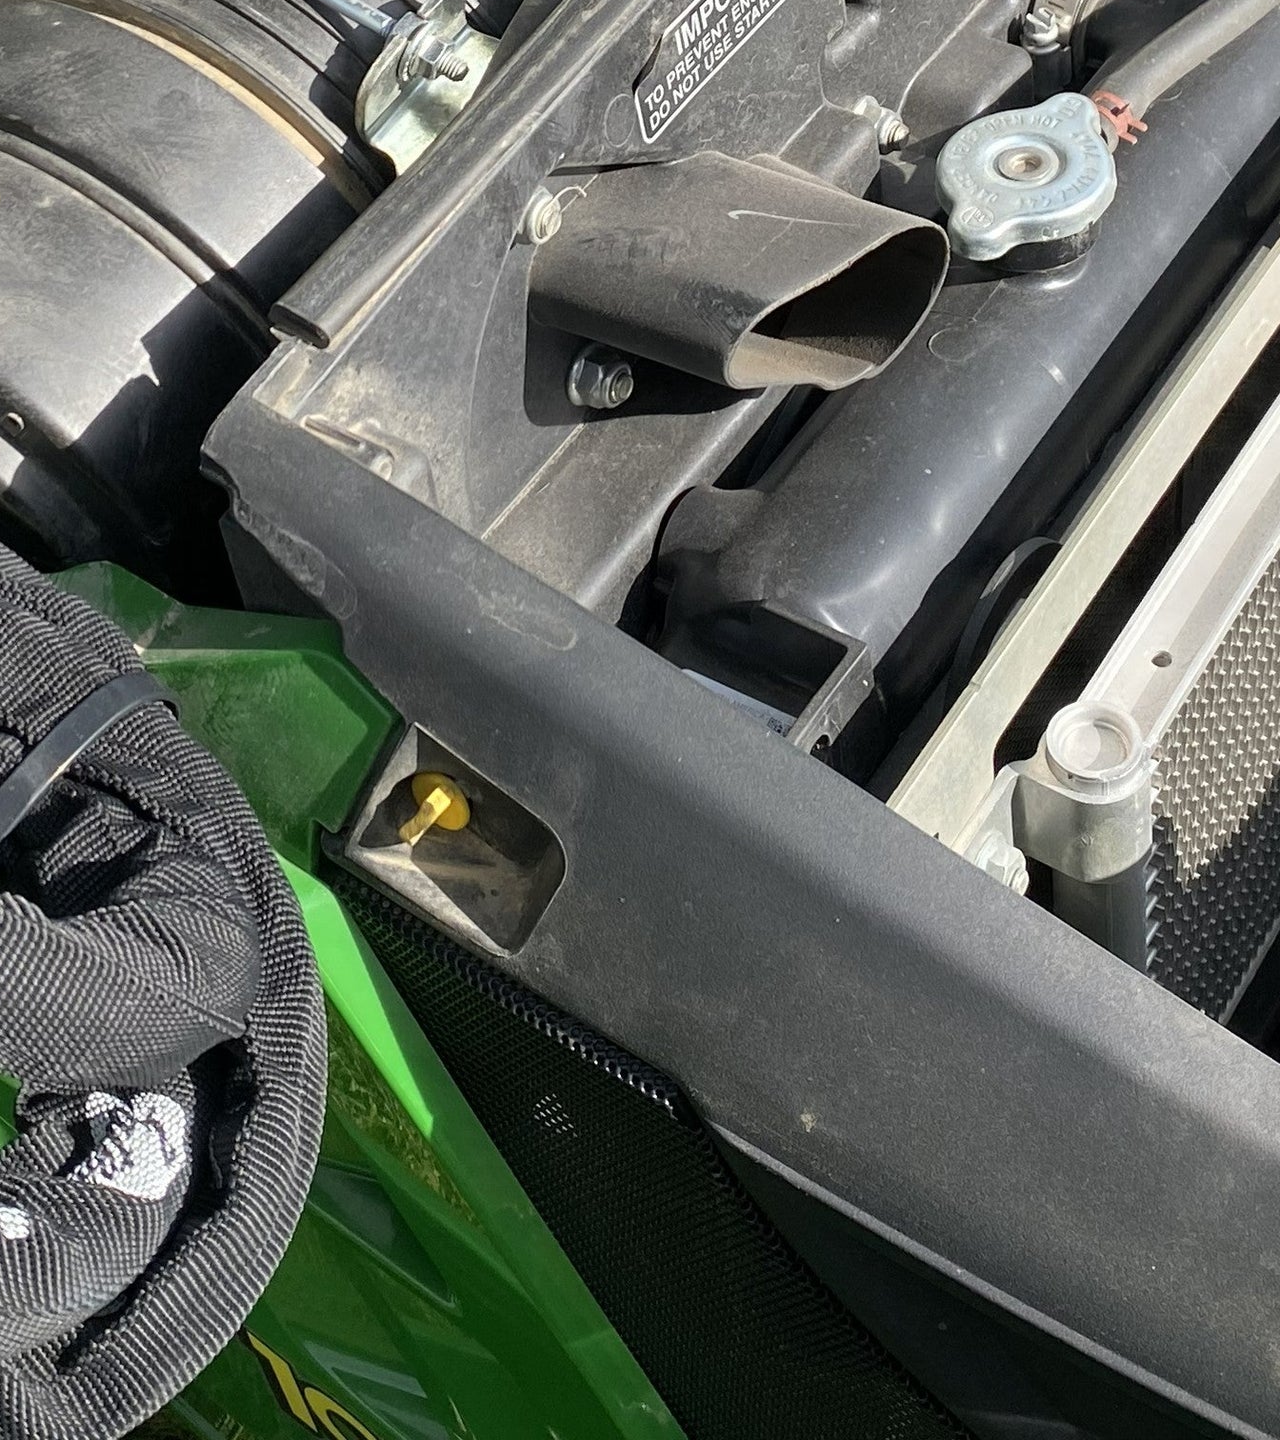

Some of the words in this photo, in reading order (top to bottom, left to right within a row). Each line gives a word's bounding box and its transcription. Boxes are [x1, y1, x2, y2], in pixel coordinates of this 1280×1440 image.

[644, 84, 665, 111] TO
[666, 14, 729, 87] PREVENT
[649, 100, 671, 132] DO
[674, 67, 701, 108] NOT
[704, 36, 734, 70] USE
